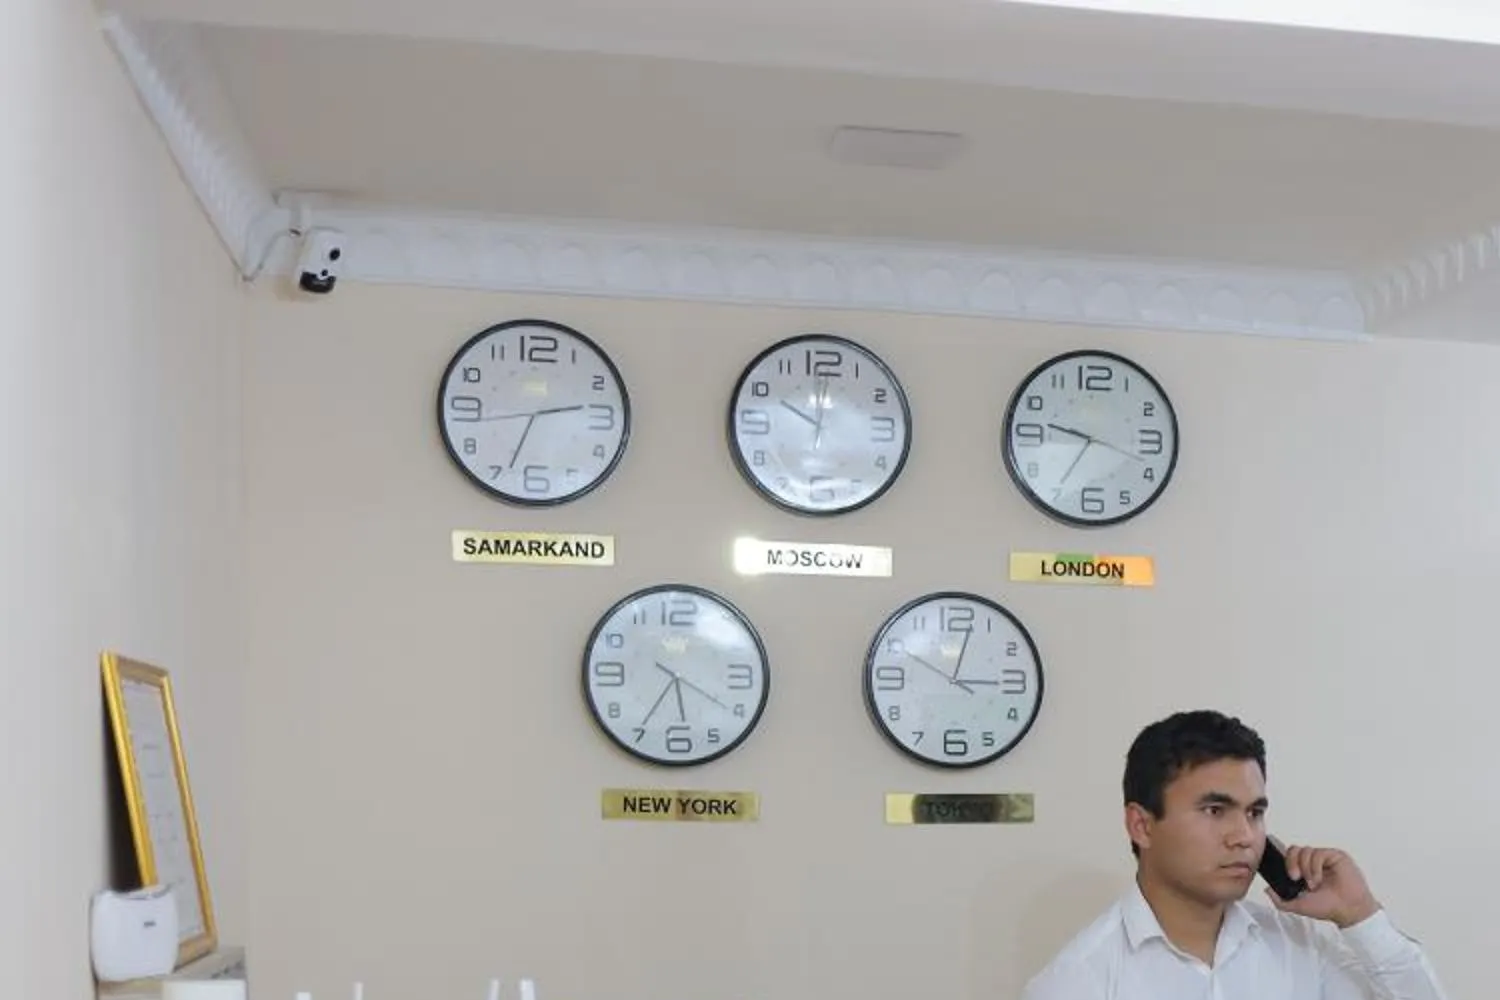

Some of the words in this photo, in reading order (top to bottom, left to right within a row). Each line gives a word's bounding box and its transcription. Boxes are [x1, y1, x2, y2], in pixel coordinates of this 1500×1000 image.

[491, 343, 505, 361] 11
[520, 335, 558, 363] 12
[779, 359, 791, 375] 11
[805, 350, 842, 377] 12
[463, 367, 481, 383] 10
[592, 375, 605, 391] 2
[1052, 374, 1064, 389] 11
[1078, 365, 1113, 391] 12
[752, 381, 769, 397] 10
[874, 388, 887, 403] 2
[451, 396, 482, 422] 9
[1027, 396, 1043, 410] 10
[1143, 402, 1155, 417] 2
[588, 404, 614, 430] 3
[870, 416, 895, 442] 3
[1016, 424, 1043, 447] 9
[463, 437, 476, 455] 8
[1138, 429, 1162, 454] 3
[592, 444, 605, 459] 4
[753, 450, 765, 466] 8
[875, 456, 887, 471] 4
[1027, 462, 1039, 478] 8
[488, 465, 502, 480] 7
[523, 465, 549, 493] 6
[1143, 467, 1154, 482] 4
[1081, 487, 1104, 514] 6
[1119, 490, 1131, 505] 5
[463, 537, 605, 560] SAMARKAND
[767, 549, 863, 569] MOSCOW
[1040, 560, 1125, 580] LONDON
[633, 608, 646, 625] 11
[661, 600, 698, 626] 12
[940, 606, 974, 632] 12
[913, 616, 925, 631] 11
[606, 633, 624, 649] 10
[1006, 642, 1017, 657] 2
[595, 662, 624, 687] 9
[727, 664, 753, 690] 3
[876, 666, 905, 690] 9
[1002, 669, 1026, 694] 3
[608, 702, 621, 719] 8
[733, 703, 745, 719] 4
[888, 705, 900, 721] 8
[1007, 708, 1018, 722] 4
[633, 727, 646, 743] 7
[665, 726, 692, 753] 6
[708, 728, 720, 743] 5
[912, 731, 924, 746] 7
[943, 729, 968, 756] 6
[982, 732, 995, 746] 5
[623, 797, 671, 815] NEW
[677, 798, 738, 816] YORK
[925, 801, 993, 819] TOK
